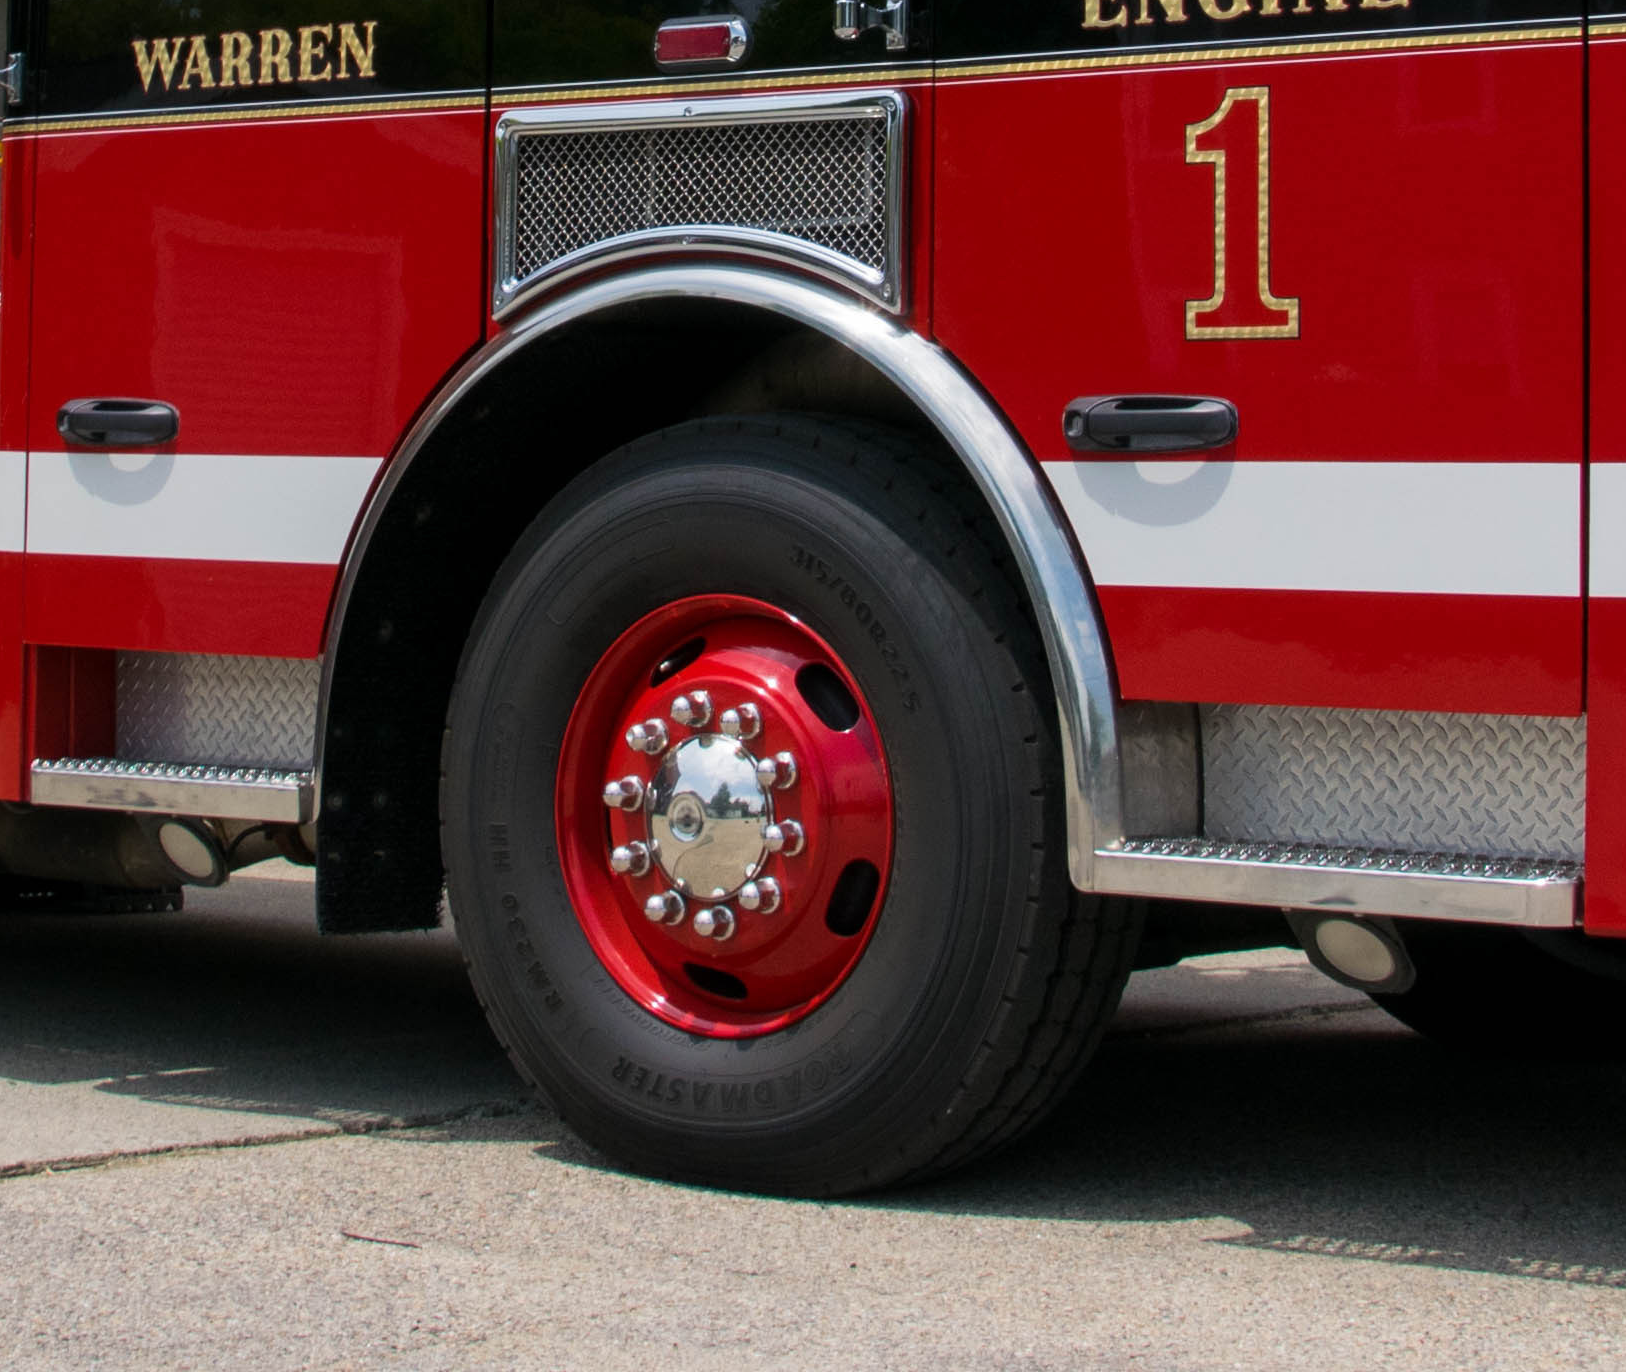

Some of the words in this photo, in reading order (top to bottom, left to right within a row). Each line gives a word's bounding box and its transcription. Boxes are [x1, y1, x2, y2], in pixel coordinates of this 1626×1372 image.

[131, 21, 379, 94] WARREN
[1185, 85, 1302, 340] 1
[611, 1041, 856, 1116] ROADMASTER
